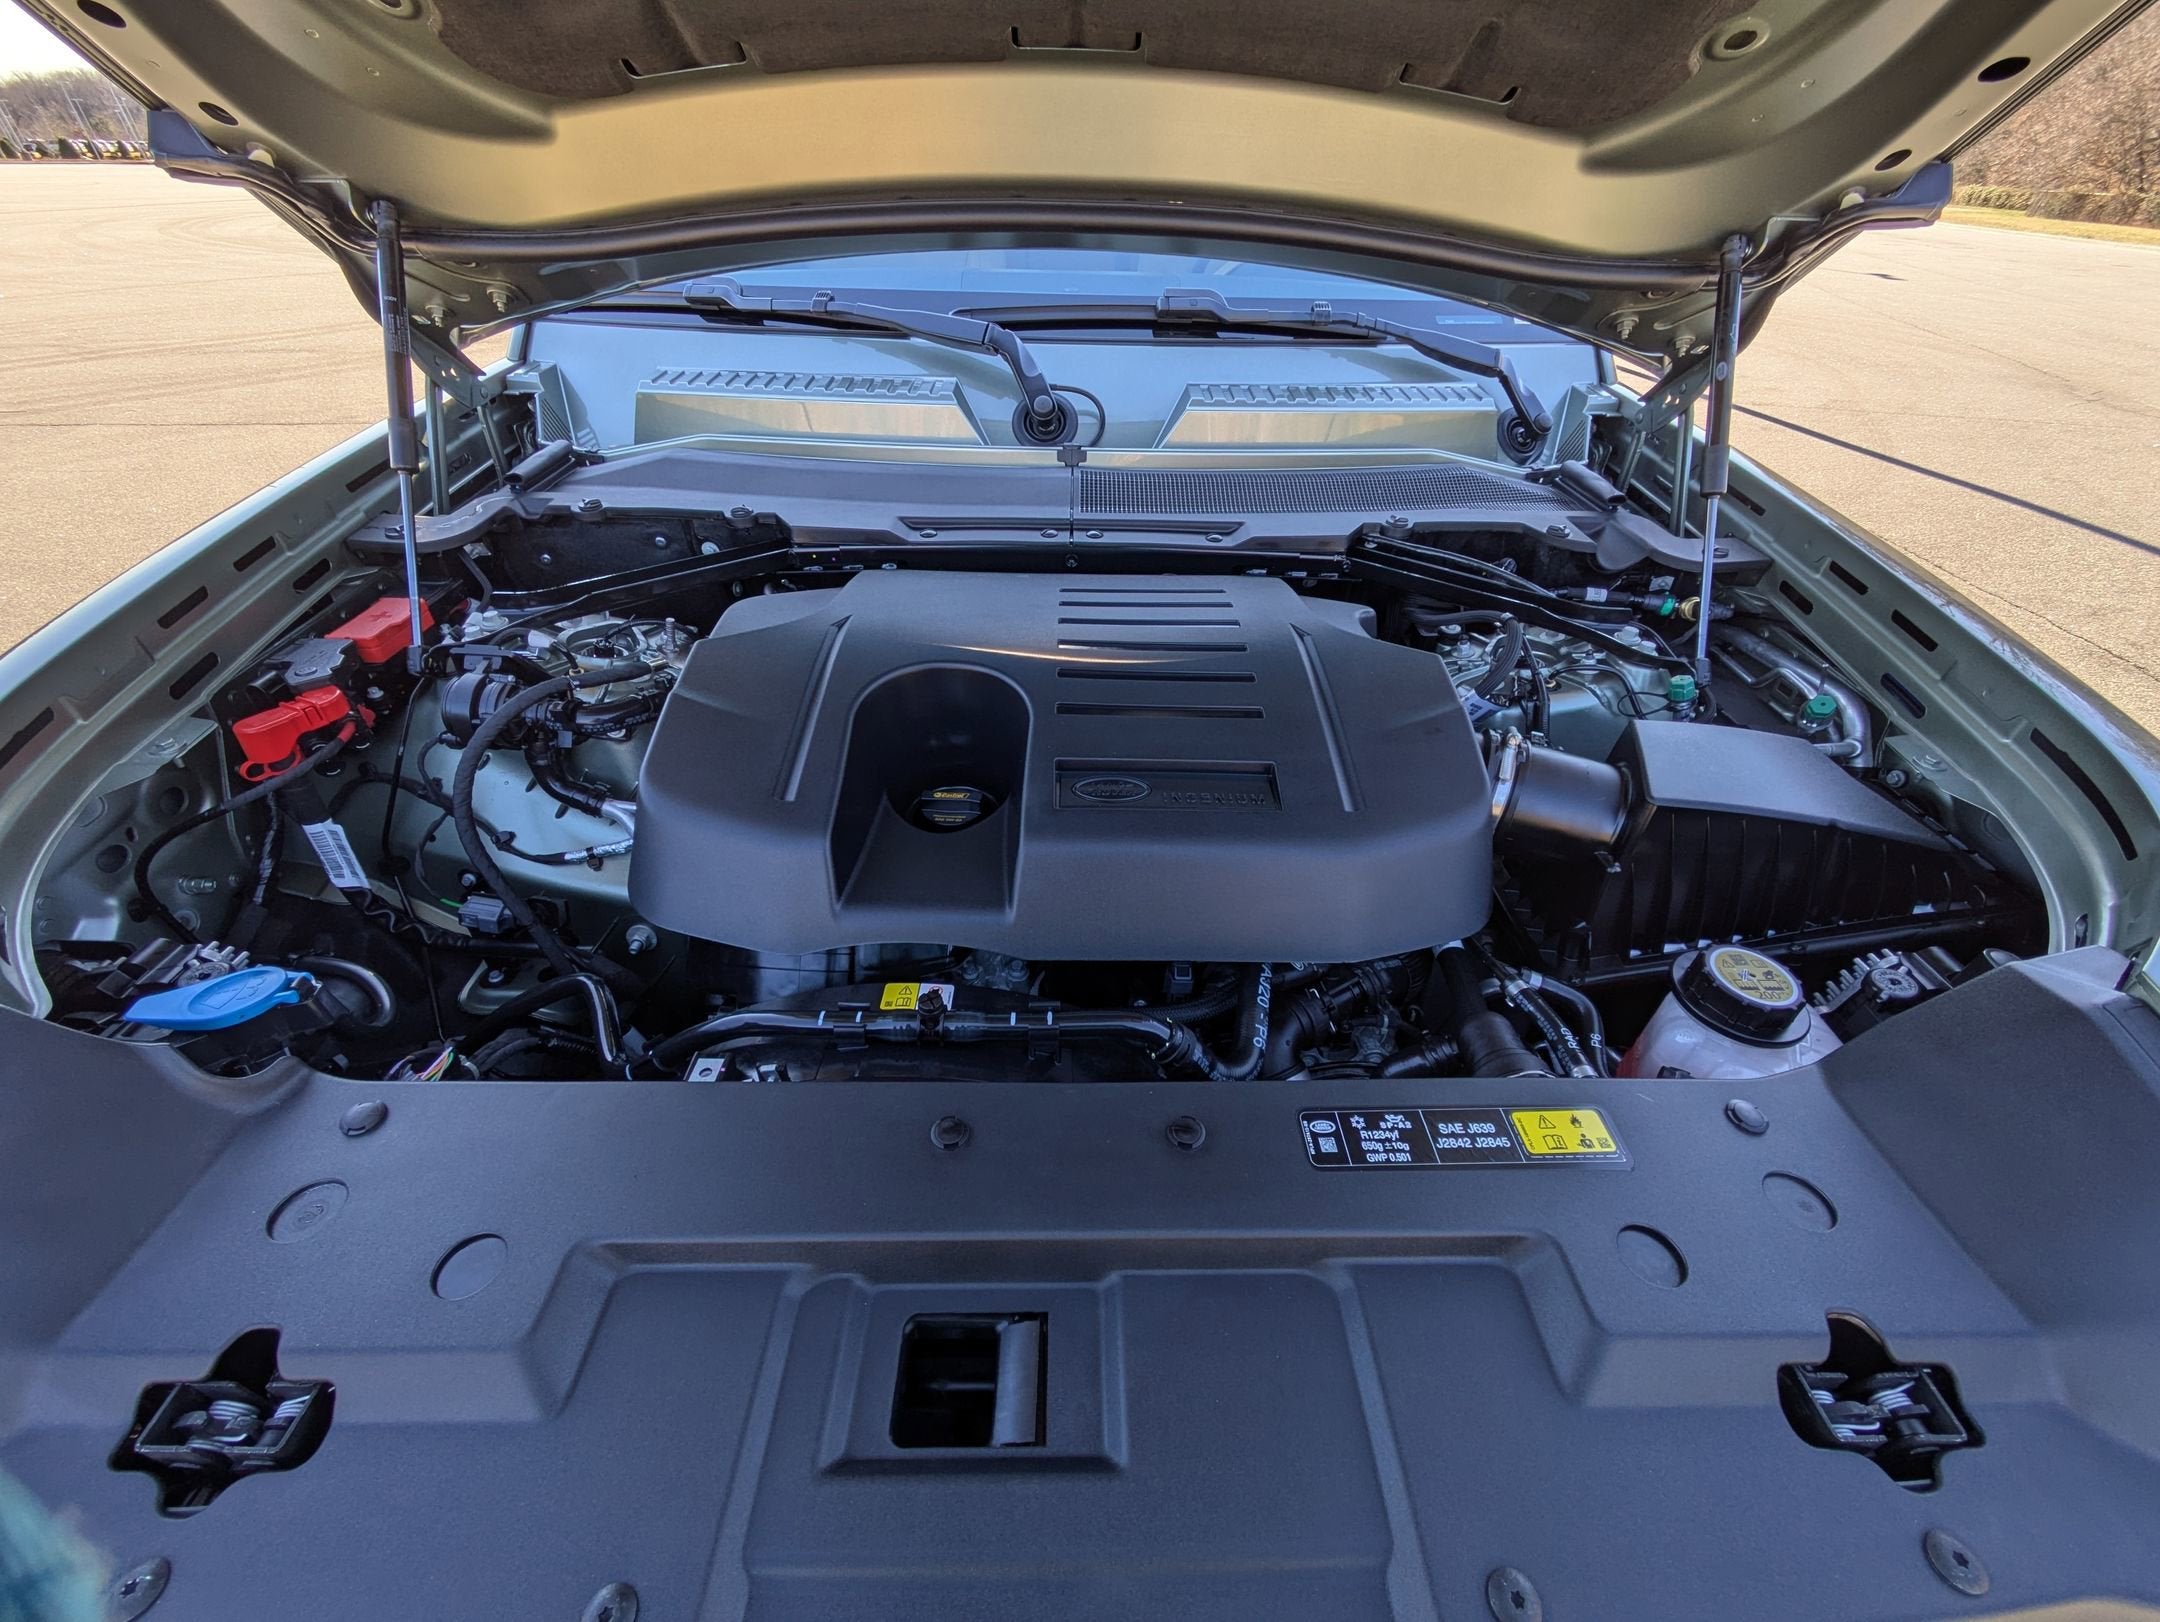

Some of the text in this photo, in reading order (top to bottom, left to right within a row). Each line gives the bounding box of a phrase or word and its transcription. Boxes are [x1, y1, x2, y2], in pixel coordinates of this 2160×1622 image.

[1163, 792, 1266, 806] INGENIUM
[1253, 1023, 1268, 1052] P6
[1438, 1123, 1496, 1134] SAE J639
[1360, 1130, 1400, 1141] R1234yf
[1361, 1141, 1410, 1152] 650g ±10g
[1436, 1137, 1511, 1149] J2842 J2845
[1366, 1153, 1412, 1162] GWP 0.501
